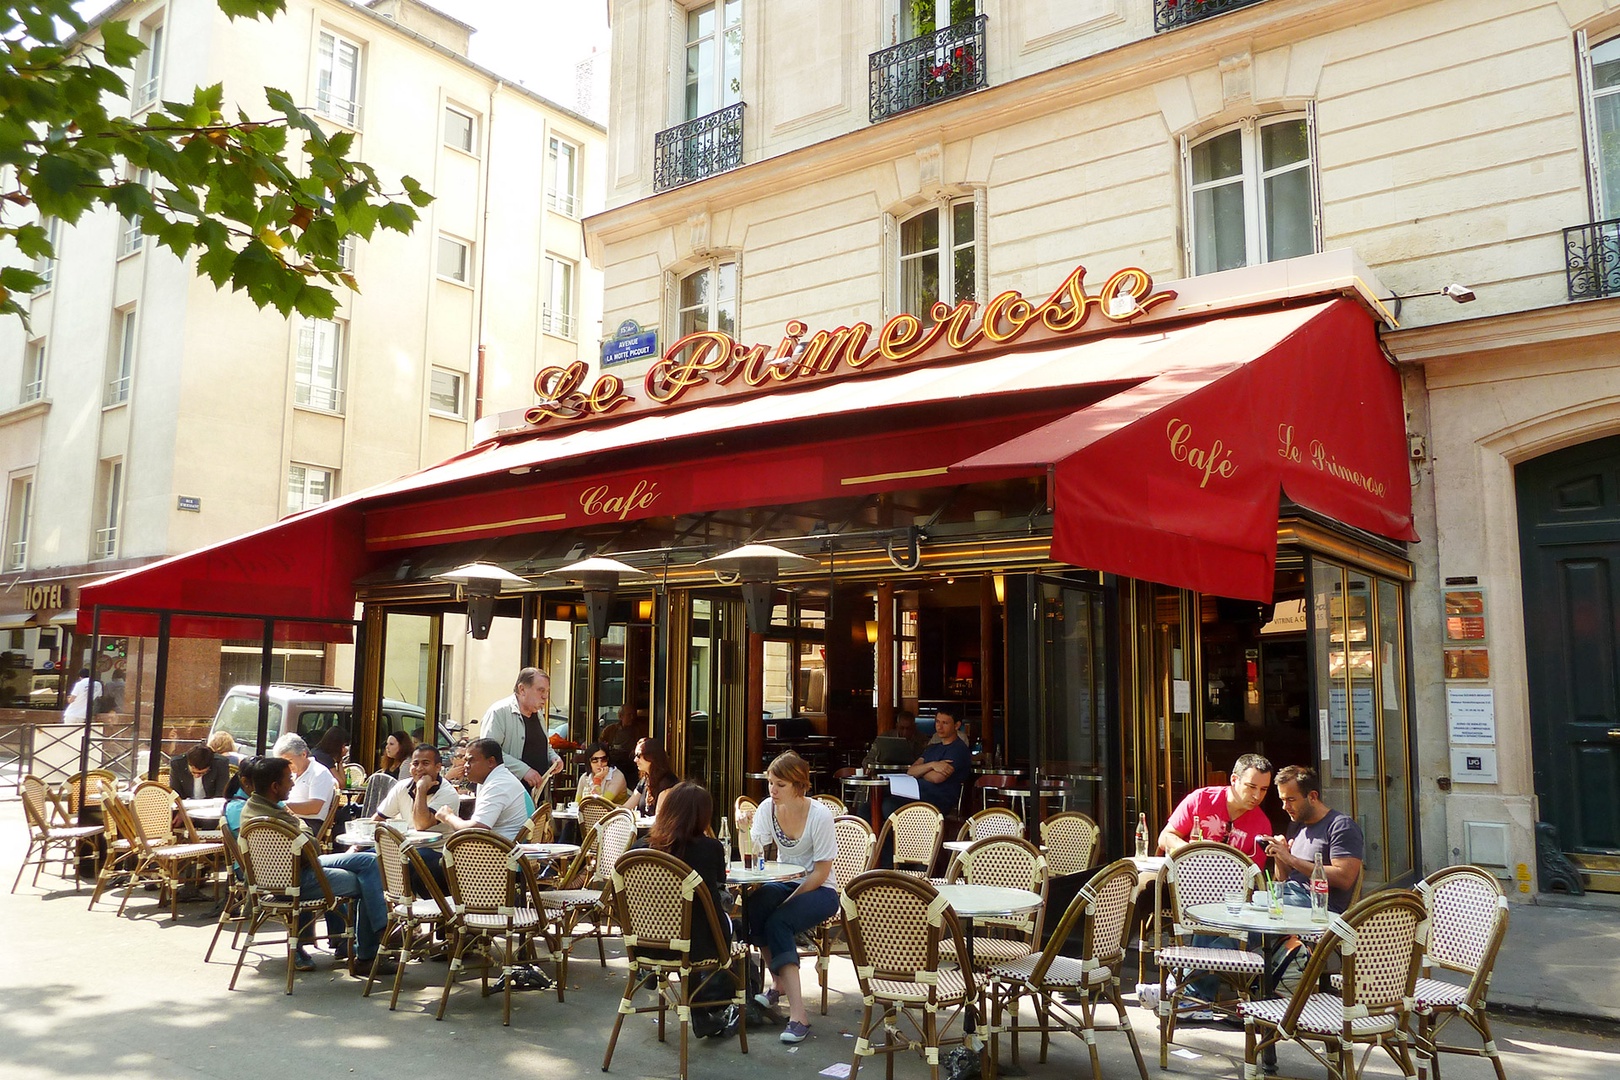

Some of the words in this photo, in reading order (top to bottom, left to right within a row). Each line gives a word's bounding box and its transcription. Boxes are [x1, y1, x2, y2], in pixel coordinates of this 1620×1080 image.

[525, 360, 635, 424] Le
[645, 265, 1179, 405] Primerose
[613, 351, 629, 360] MOTTE
[630, 346, 650, 357] PICQUET
[619, 338, 639, 348] AVENUE
[1166, 418, 1239, 489] Café
[1277, 423, 1303, 464] Le
[1310, 440, 1387, 498] Primerose
[579, 479, 662, 521] Café
[24, 585, 62, 610] HOTEL
[1274, 617, 1293, 625] VITRINE
